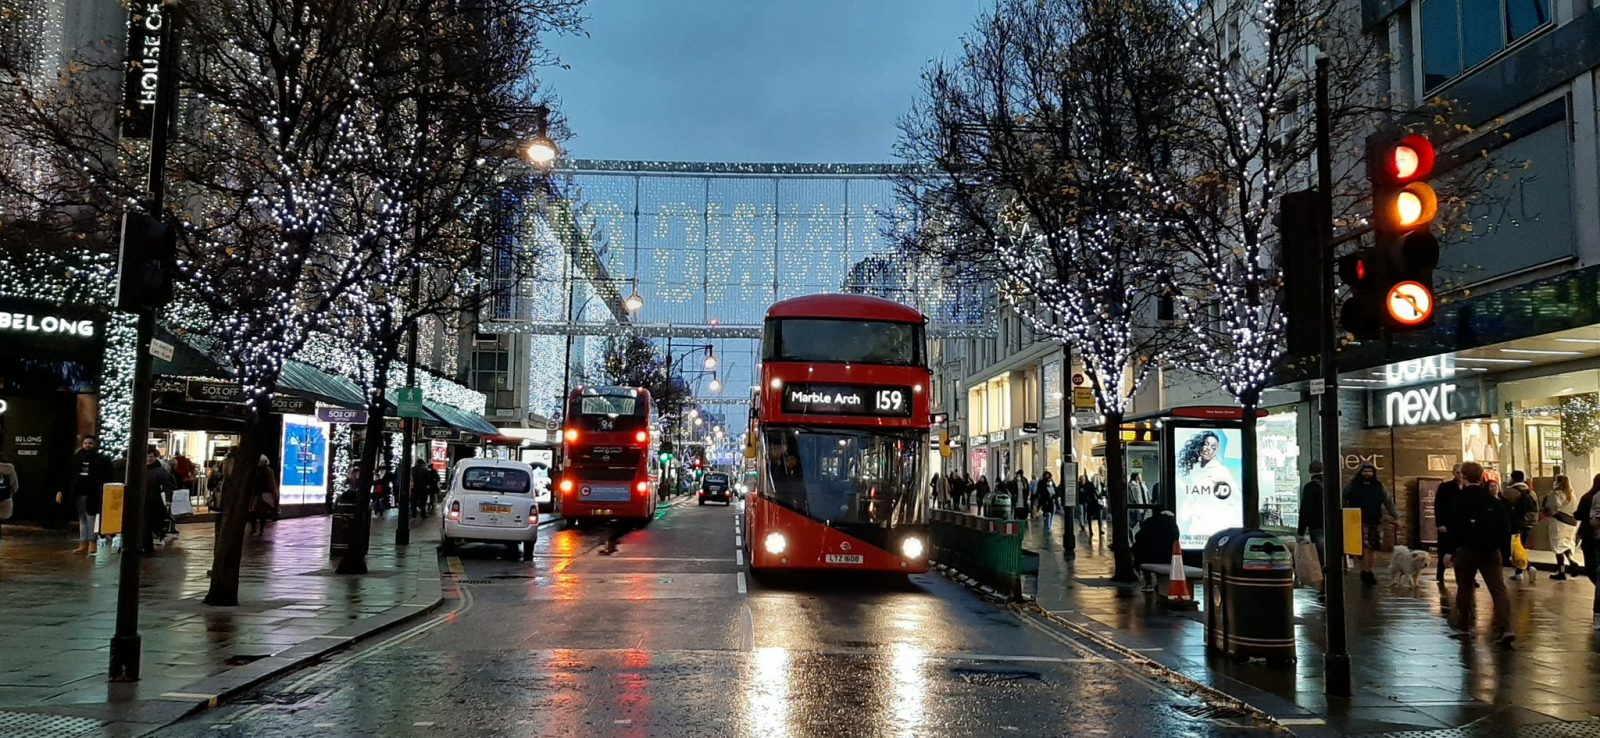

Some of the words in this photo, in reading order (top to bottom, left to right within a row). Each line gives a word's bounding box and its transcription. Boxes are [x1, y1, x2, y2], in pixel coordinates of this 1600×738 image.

[140, 35, 160, 104] HOUSE
[0, 311, 94, 336] BELONG
[202, 386, 220, 395] 50%
[222, 387, 239, 396] OFF
[791, 391, 831, 404] Marble
[834, 393, 860, 405] Arch
[876, 390, 902, 410] 159
[1385, 382, 1457, 426] next
[601, 420, 613, 429] 94
[1191, 485, 1211, 495] AM
